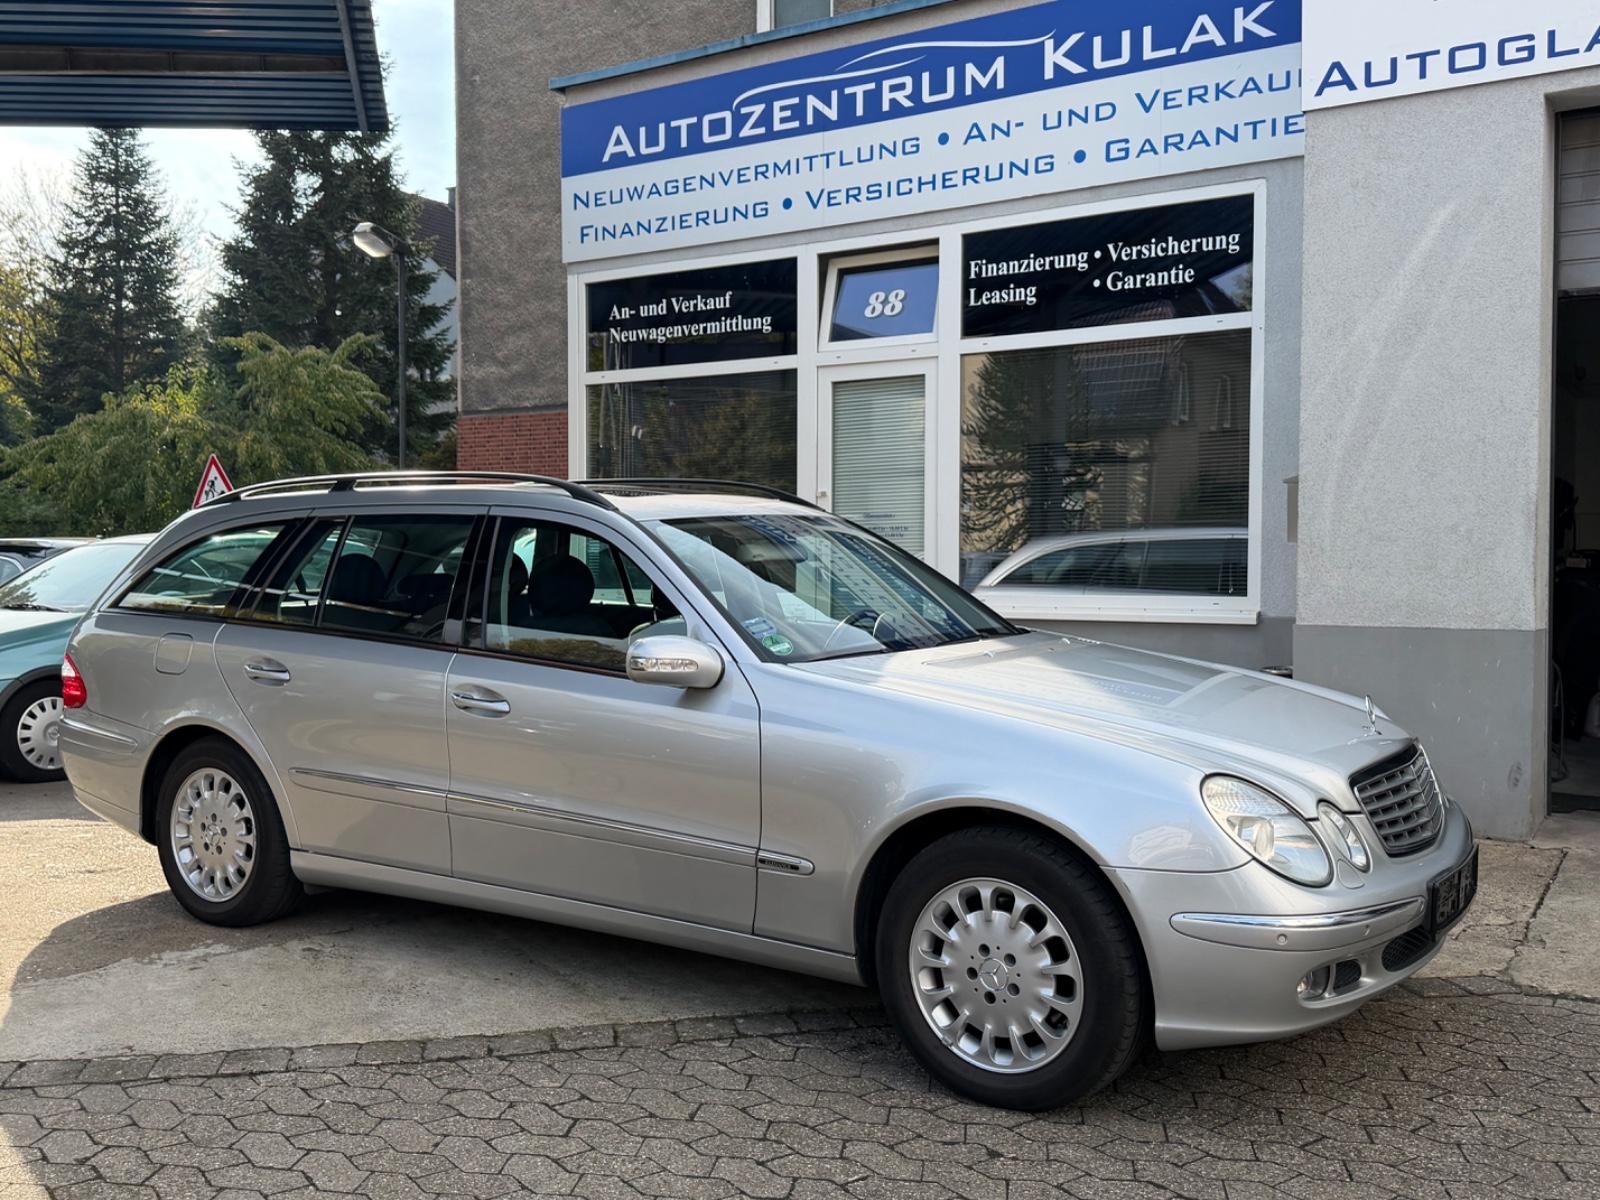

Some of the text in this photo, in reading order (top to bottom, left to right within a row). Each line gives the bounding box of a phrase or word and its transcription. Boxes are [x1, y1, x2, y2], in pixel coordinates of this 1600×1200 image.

[602, 1, 1277, 162] AUTOZENTRUM KULAK
[573, 69, 1302, 210] NEUWAGENVERMITTLUNG AN- UND VERKAU
[580, 113, 1304, 244] FINANZIERUNG VERSICHERUNG GARANTIE
[969, 233, 1241, 279] Finanzierung Versicherung
[609, 291, 733, 321] An- und Verkauf
[864, 289, 905, 318] 88
[969, 264, 1195, 307] Leasing Garantie
[609, 315, 772, 344] Neuwagenvermittlung
